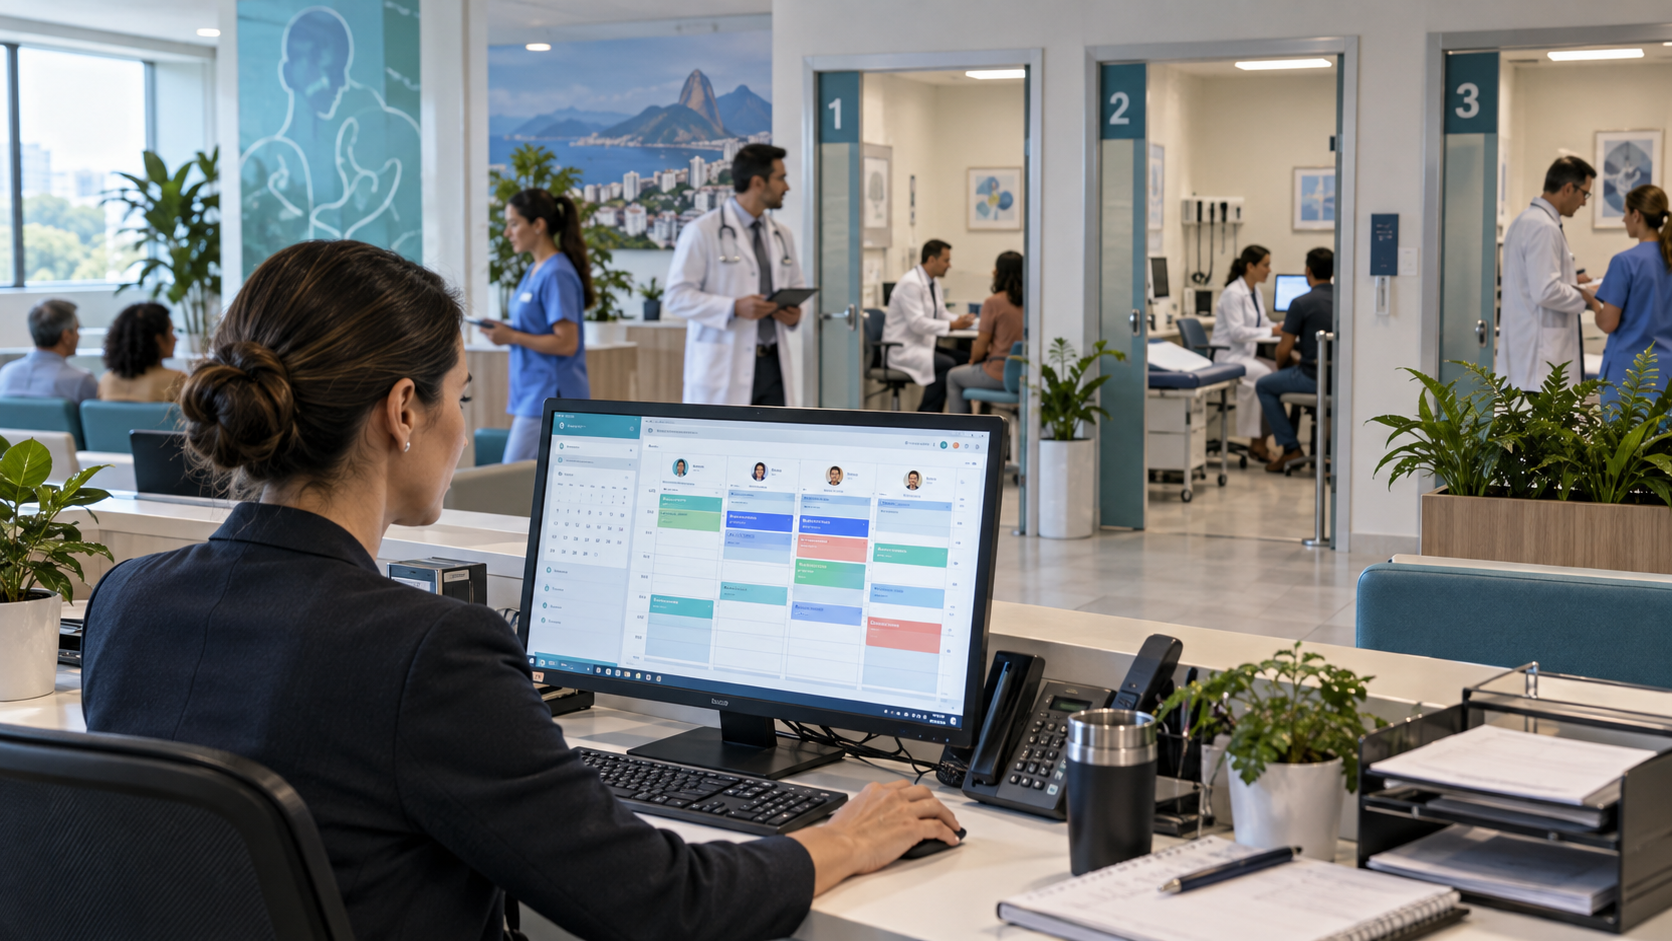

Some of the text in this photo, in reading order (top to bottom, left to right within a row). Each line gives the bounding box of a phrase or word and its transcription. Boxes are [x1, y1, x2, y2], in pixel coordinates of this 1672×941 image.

[828, 98, 842, 130] 1
[1109, 91, 1131, 125] 2
[1455, 82, 1480, 119] 3
